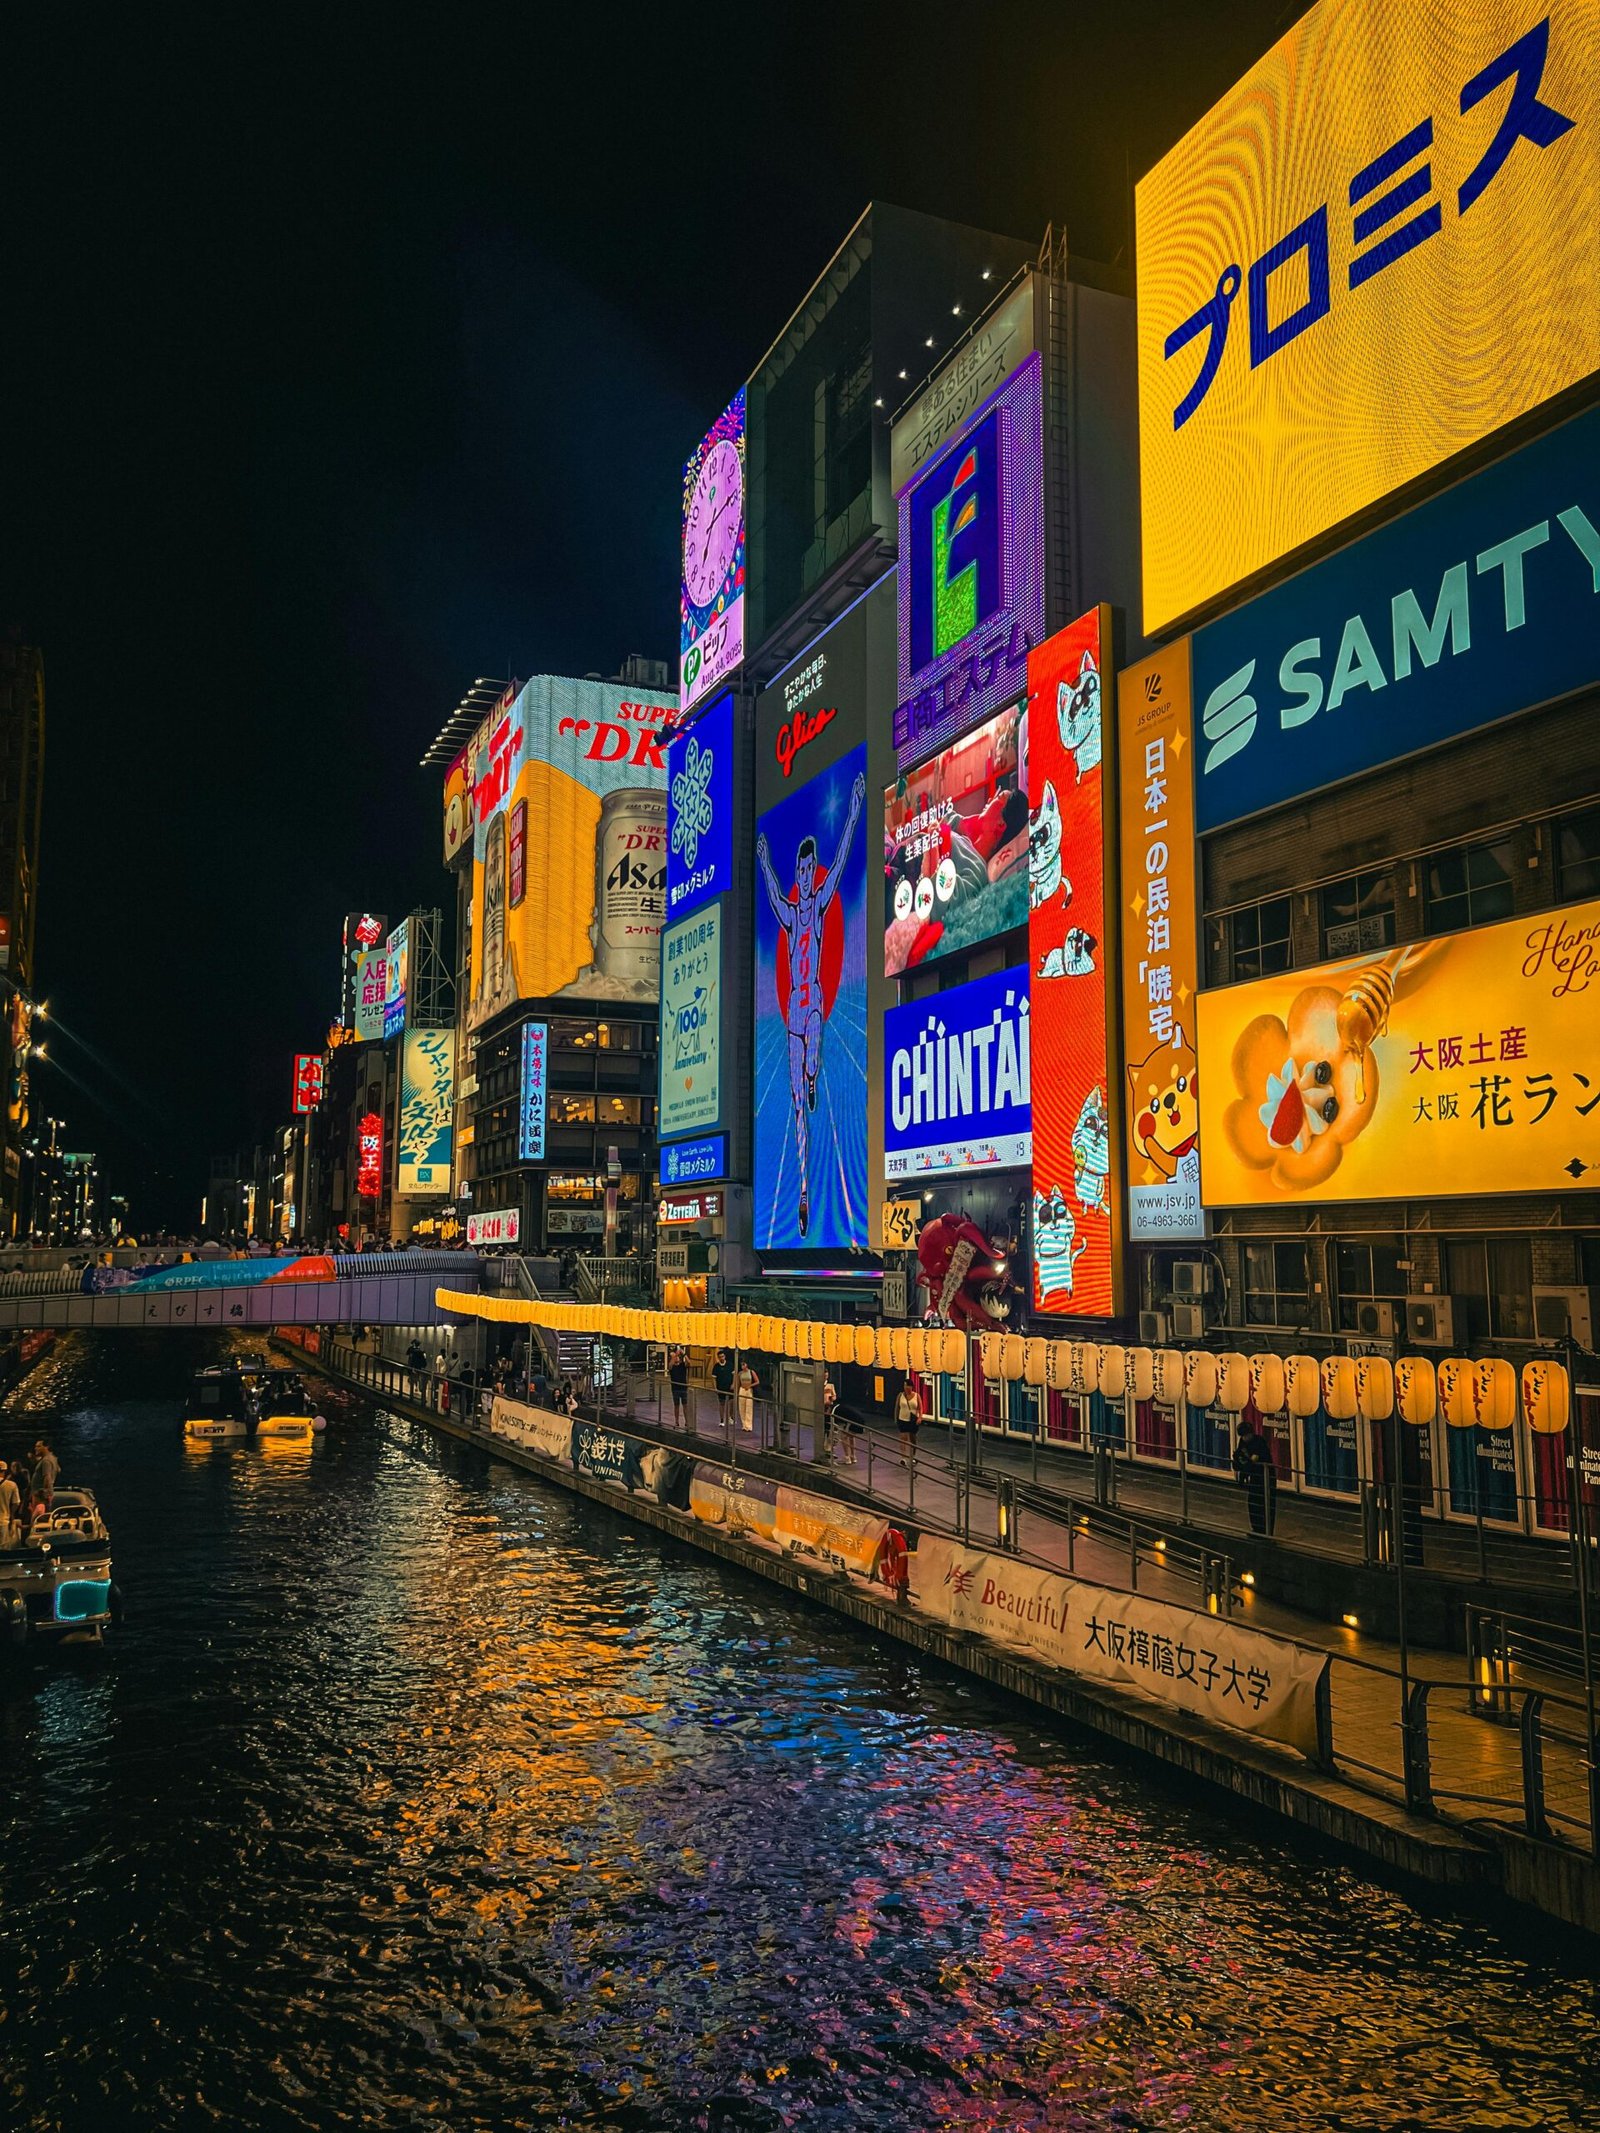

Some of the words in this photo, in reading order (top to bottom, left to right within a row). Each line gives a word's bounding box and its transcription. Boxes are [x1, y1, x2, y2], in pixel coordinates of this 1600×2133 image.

[1165, 17, 1577, 431] プロミス
[912, 347, 1006, 468] エステムシリーズ
[703, 616, 729, 666] ピップ
[726, 640, 742, 665] 2025
[617, 702, 685, 726] SUPE
[1138, 715, 1145, 726] JS
[1146, 702, 1171, 721] GROUP
[775, 708, 838, 778] Glico
[895, 796, 954, 844] 体の回復助ける
[1144, 737, 1170, 955] 日本一の民泊
[640, 896, 662, 914] 生
[671, 864, 715, 906] 雪印メグミルク
[668, 920, 715, 962] 創業100周年
[362, 958, 386, 982] 入店
[674, 952, 708, 986] ありがとう
[799, 926, 811, 1008] グリコ
[1409, 1025, 1528, 1074] 大阪土産
[891, 1010, 1031, 1132] CHINTAI
[1412, 1092, 1460, 1124] 大阪
[1469, 1072, 1600, 1130] 花ラン
[668, 1202, 700, 1219] ZETTERIA
[1137, 1193, 1196, 1210] www.jsv.jp
[1137, 1214, 1197, 1228] 06-4963-3661
[890, 1207, 913, 1243] くくる
[148, 1303, 244, 1318] えびす橋
[1490, 1435, 1511, 1448] Street
[981, 1578, 1070, 1634] Beautiful
[1083, 1615, 1272, 1711] 大阪樟蔭女子大学
